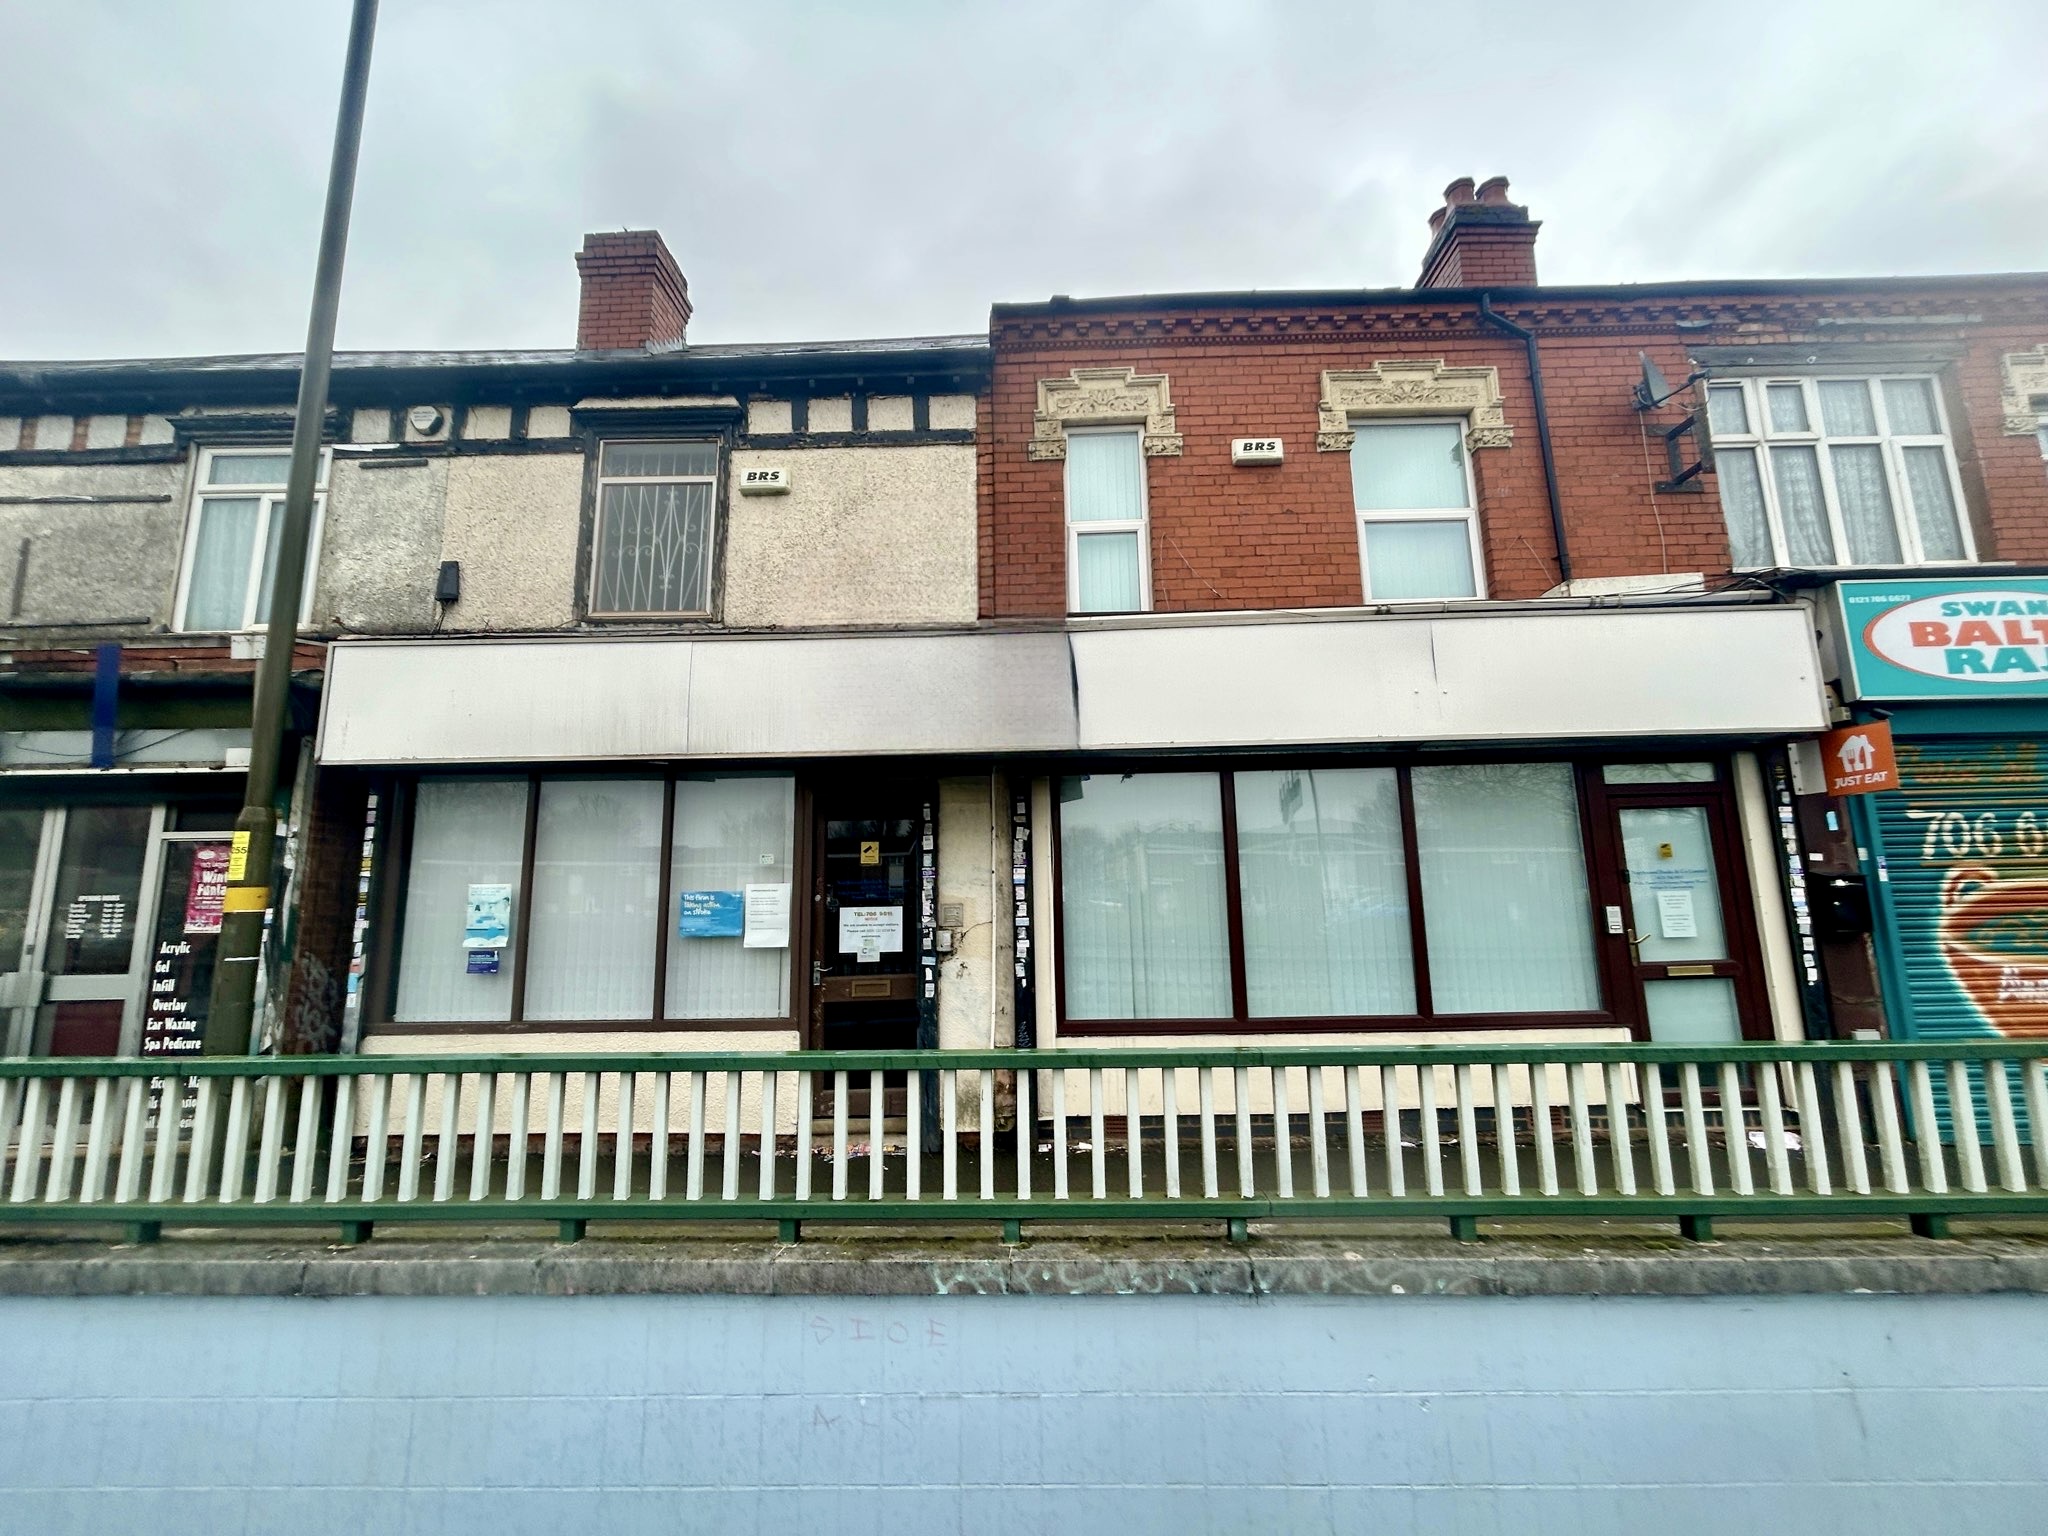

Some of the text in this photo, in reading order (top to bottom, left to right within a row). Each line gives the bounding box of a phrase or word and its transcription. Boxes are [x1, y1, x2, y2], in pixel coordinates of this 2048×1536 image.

[1243, 441, 1276, 451] BRS
[746, 471, 780, 481] BRS
[1908, 619, 2048, 647] BALT
[1834, 771, 1888, 789] JUST EAT
[1905, 810, 2003, 860] 706
[161, 941, 191, 955] Acrylic
[155, 960, 171, 973] Gel
[153, 998, 187, 1012] Overlay
[146, 1018, 197, 1032] Ear Waxing
[144, 1037, 202, 1051] Spa Pedicure
